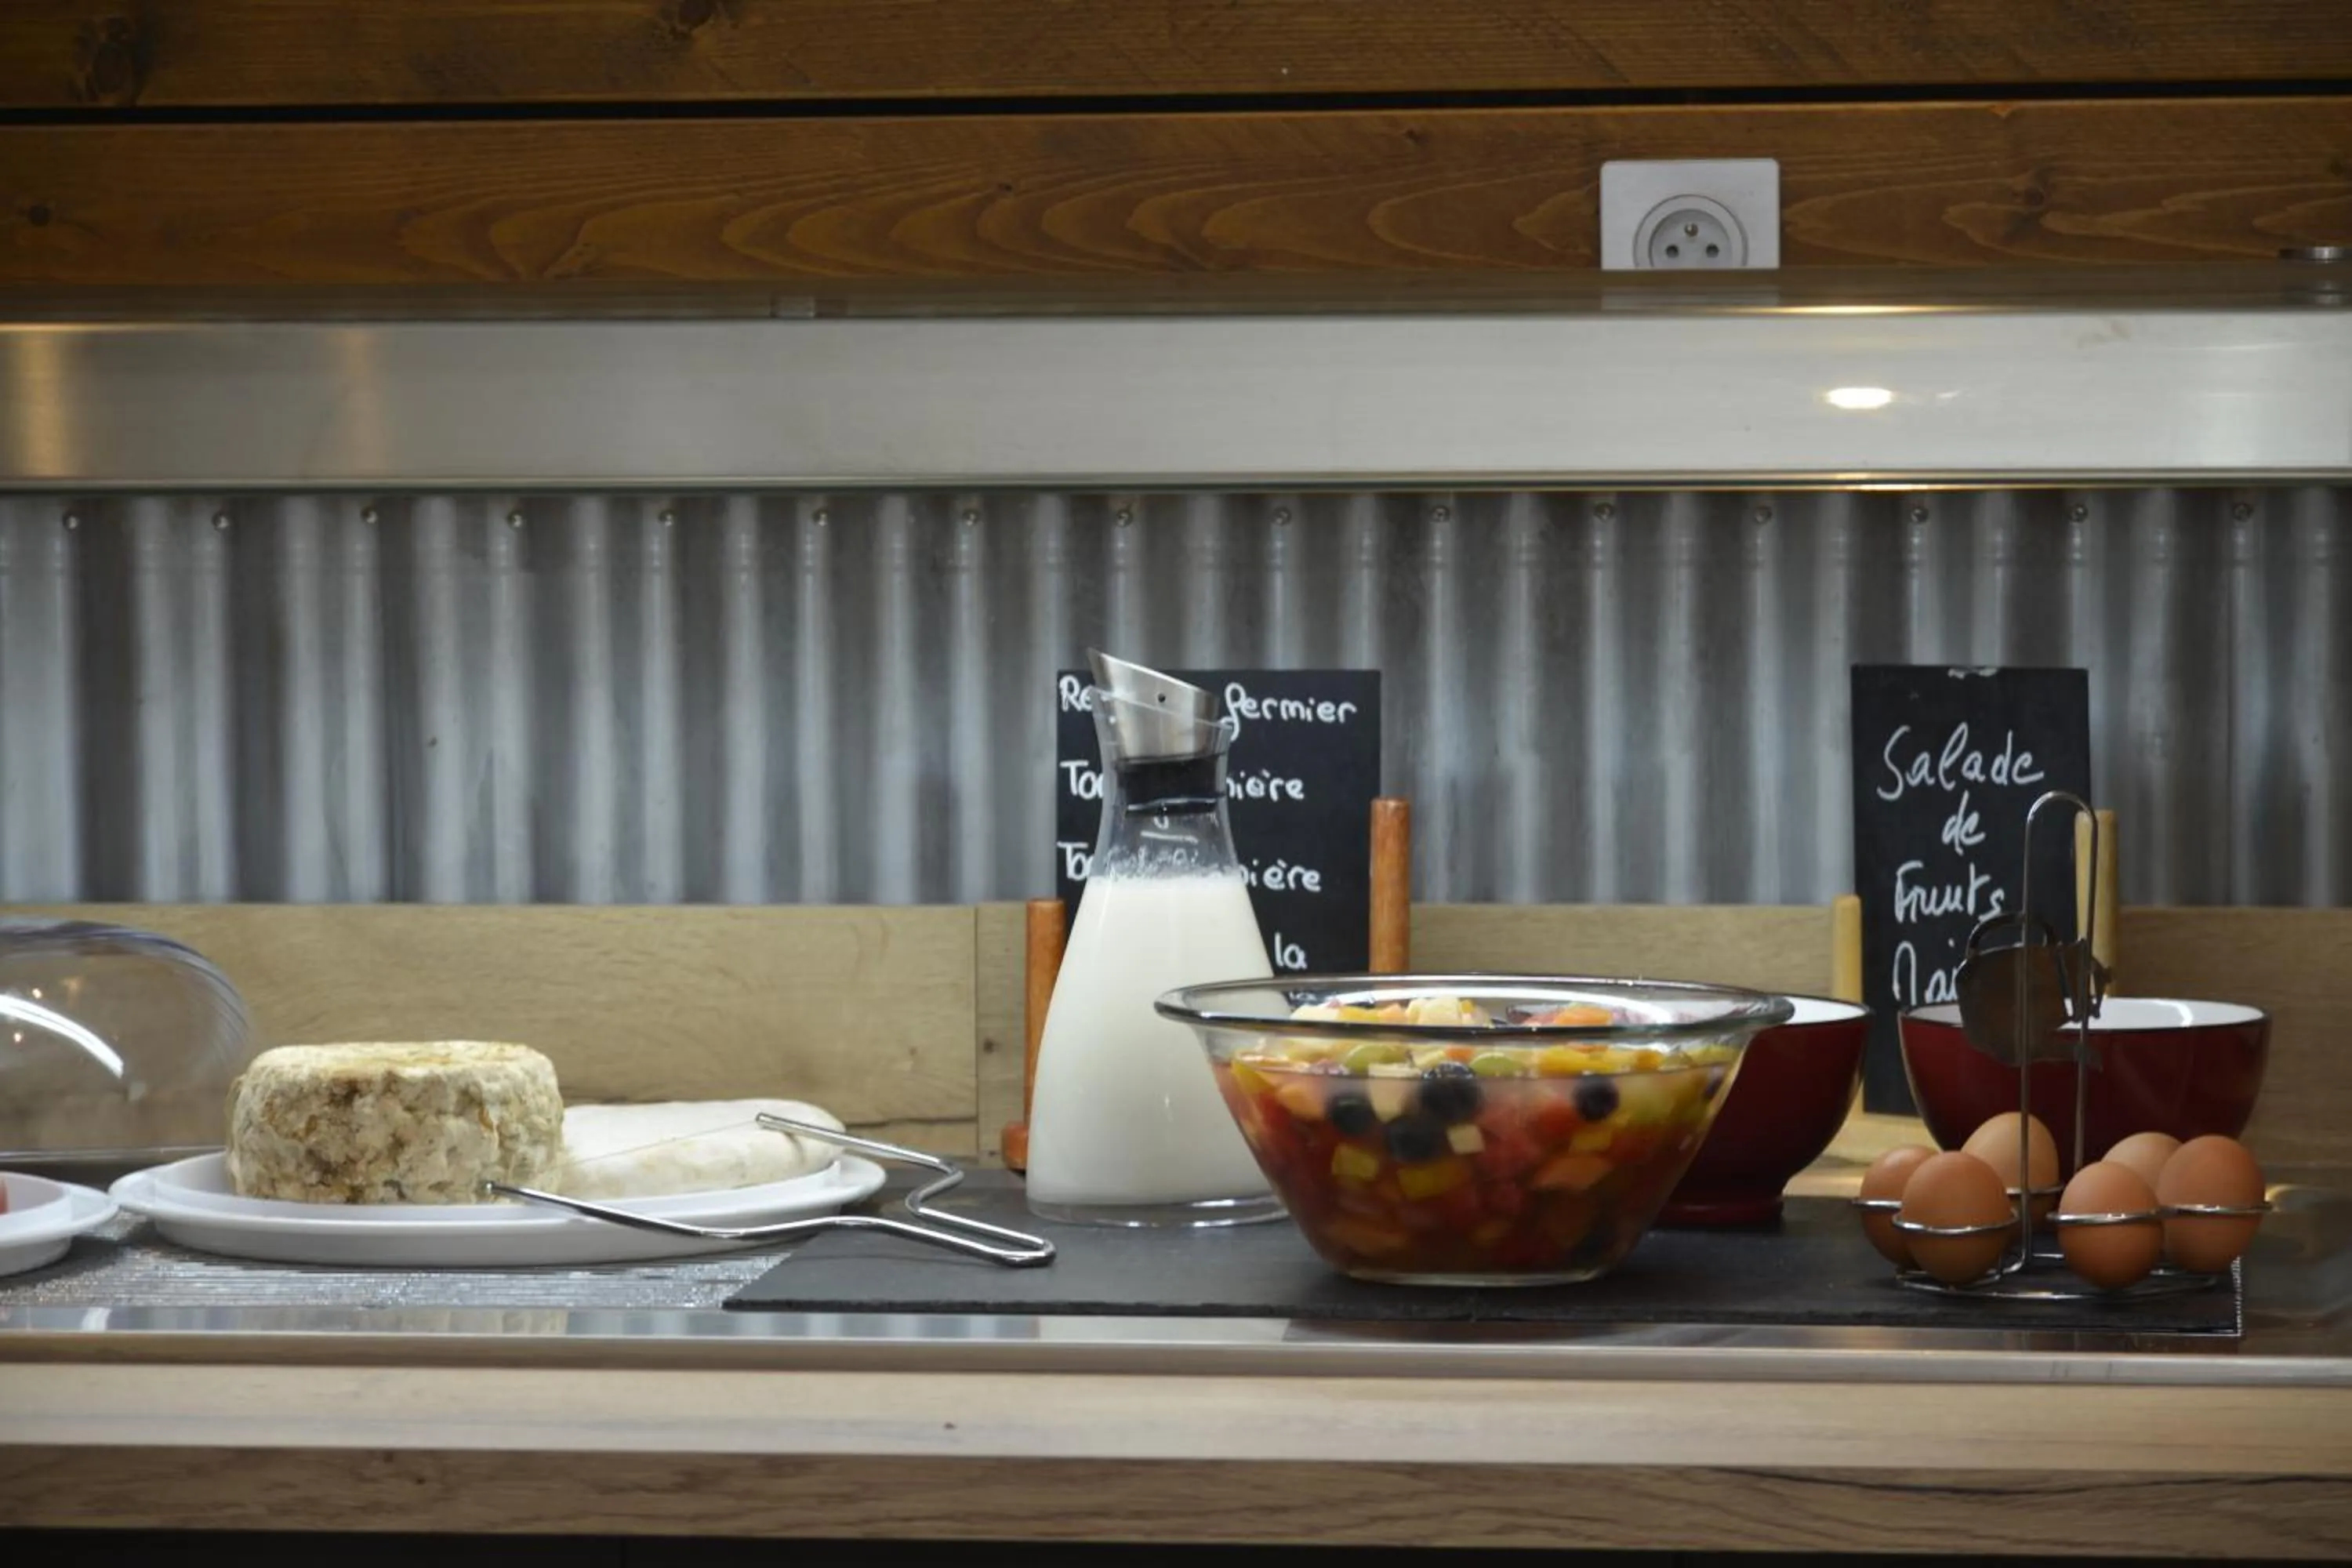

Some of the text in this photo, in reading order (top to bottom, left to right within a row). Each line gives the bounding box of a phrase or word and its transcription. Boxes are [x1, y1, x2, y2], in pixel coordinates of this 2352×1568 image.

[1876, 721, 2045, 801] Salade
[1941, 789, 1986, 856] de
[1893, 859, 2005, 924] Fruits
